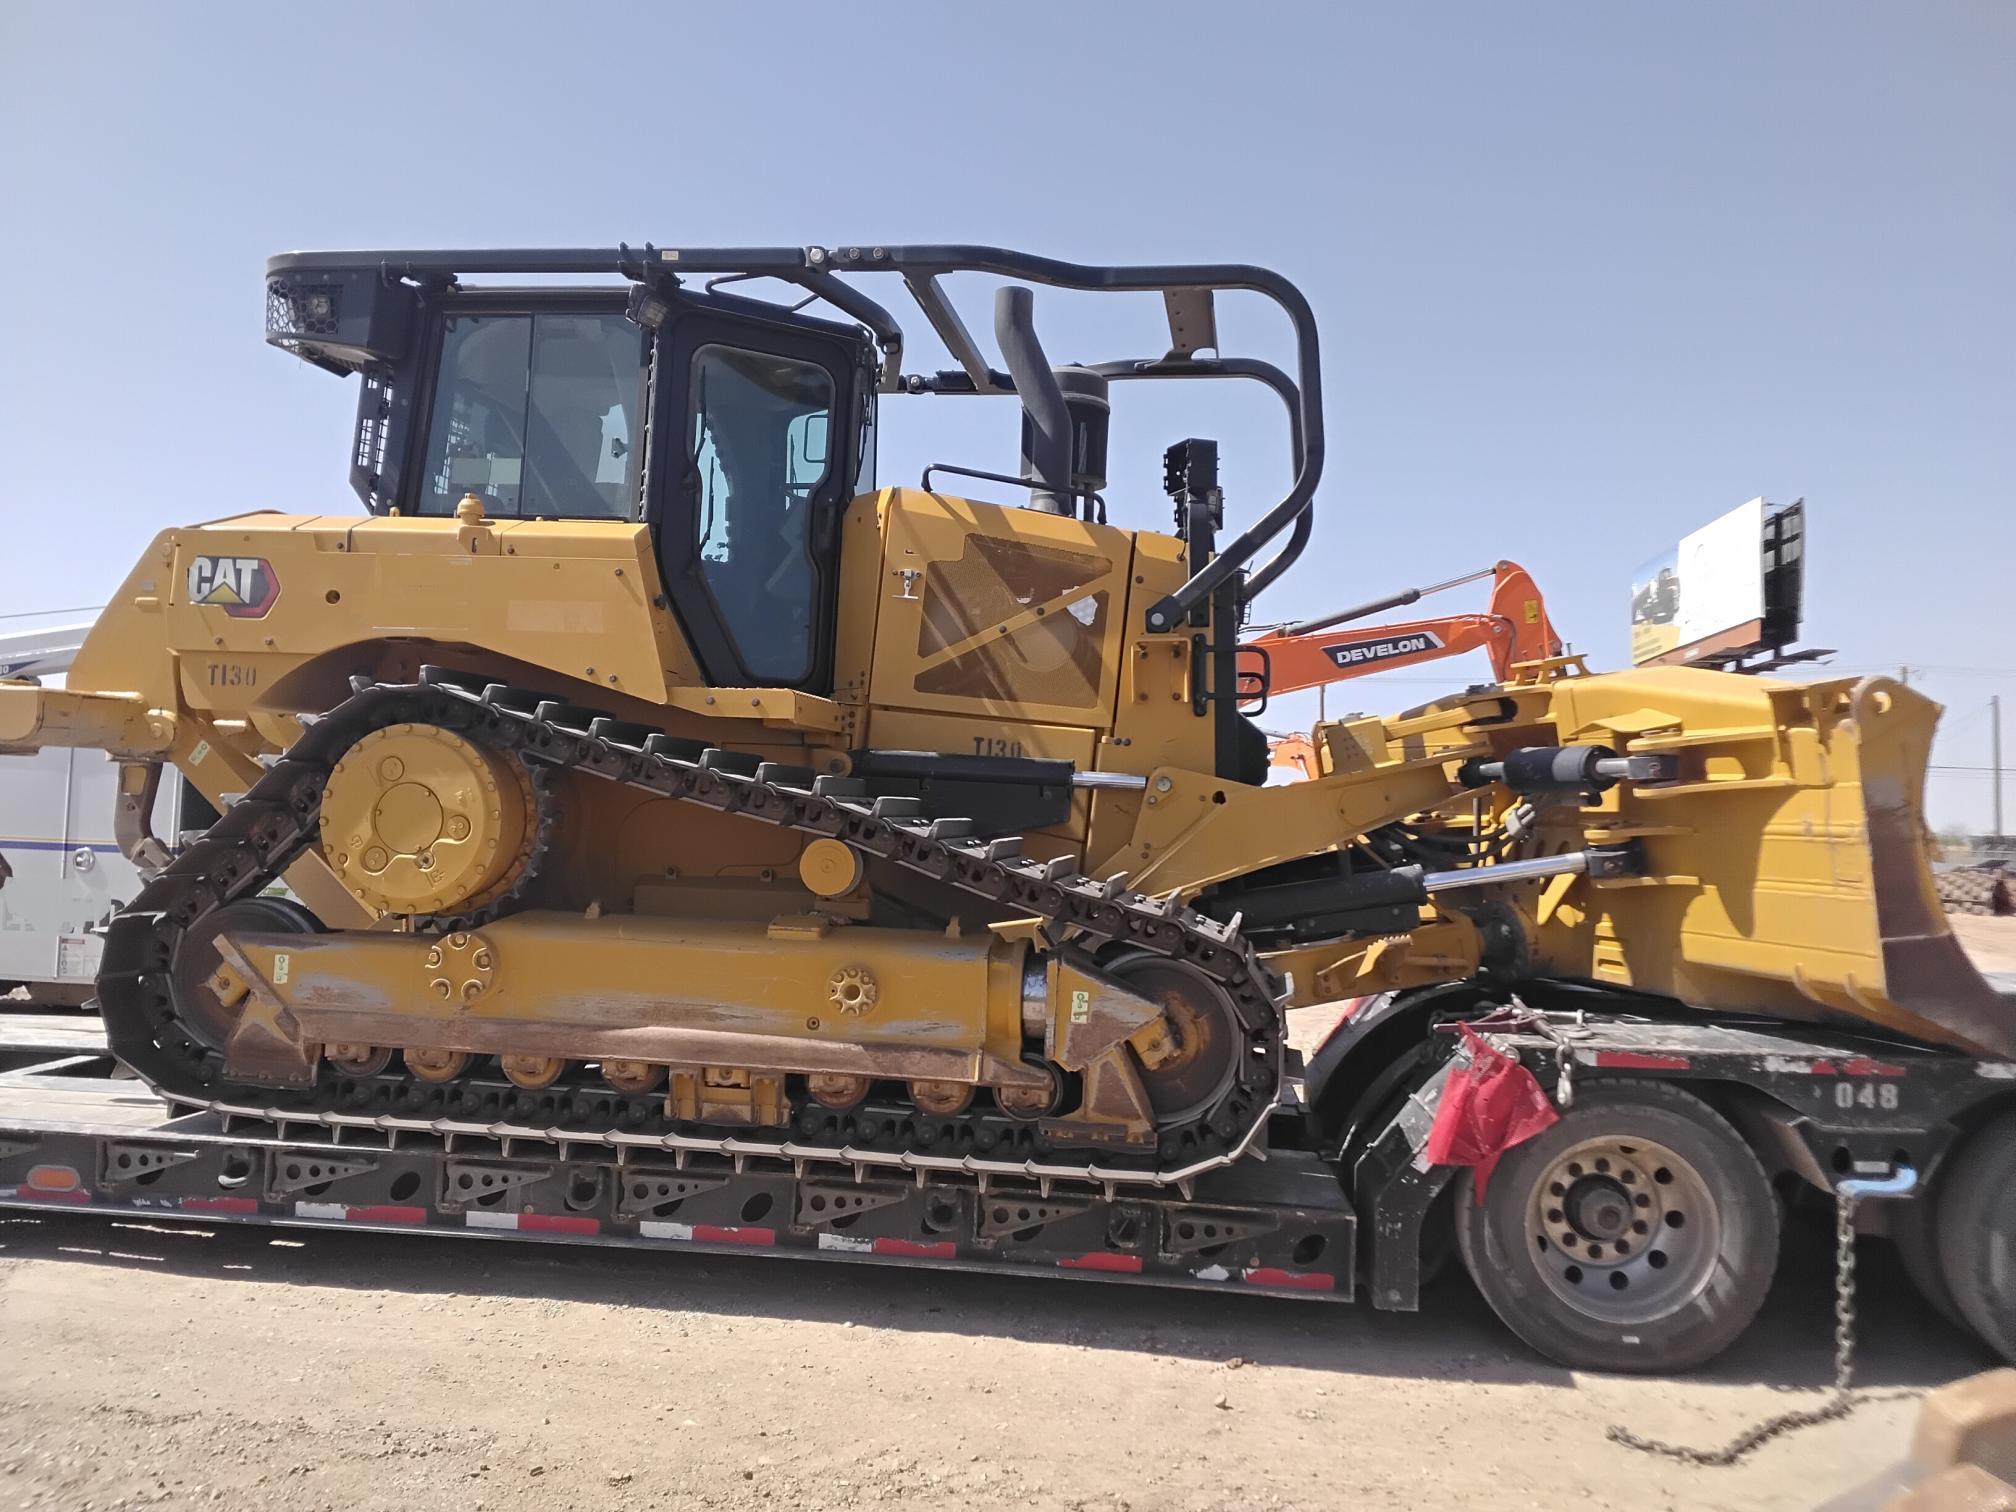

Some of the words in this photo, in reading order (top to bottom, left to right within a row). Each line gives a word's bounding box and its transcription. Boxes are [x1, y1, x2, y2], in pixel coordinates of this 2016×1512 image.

[188, 556, 259, 604] CAT
[1336, 637, 1426, 664] DEVELON
[1834, 1082, 1899, 1109] 048
